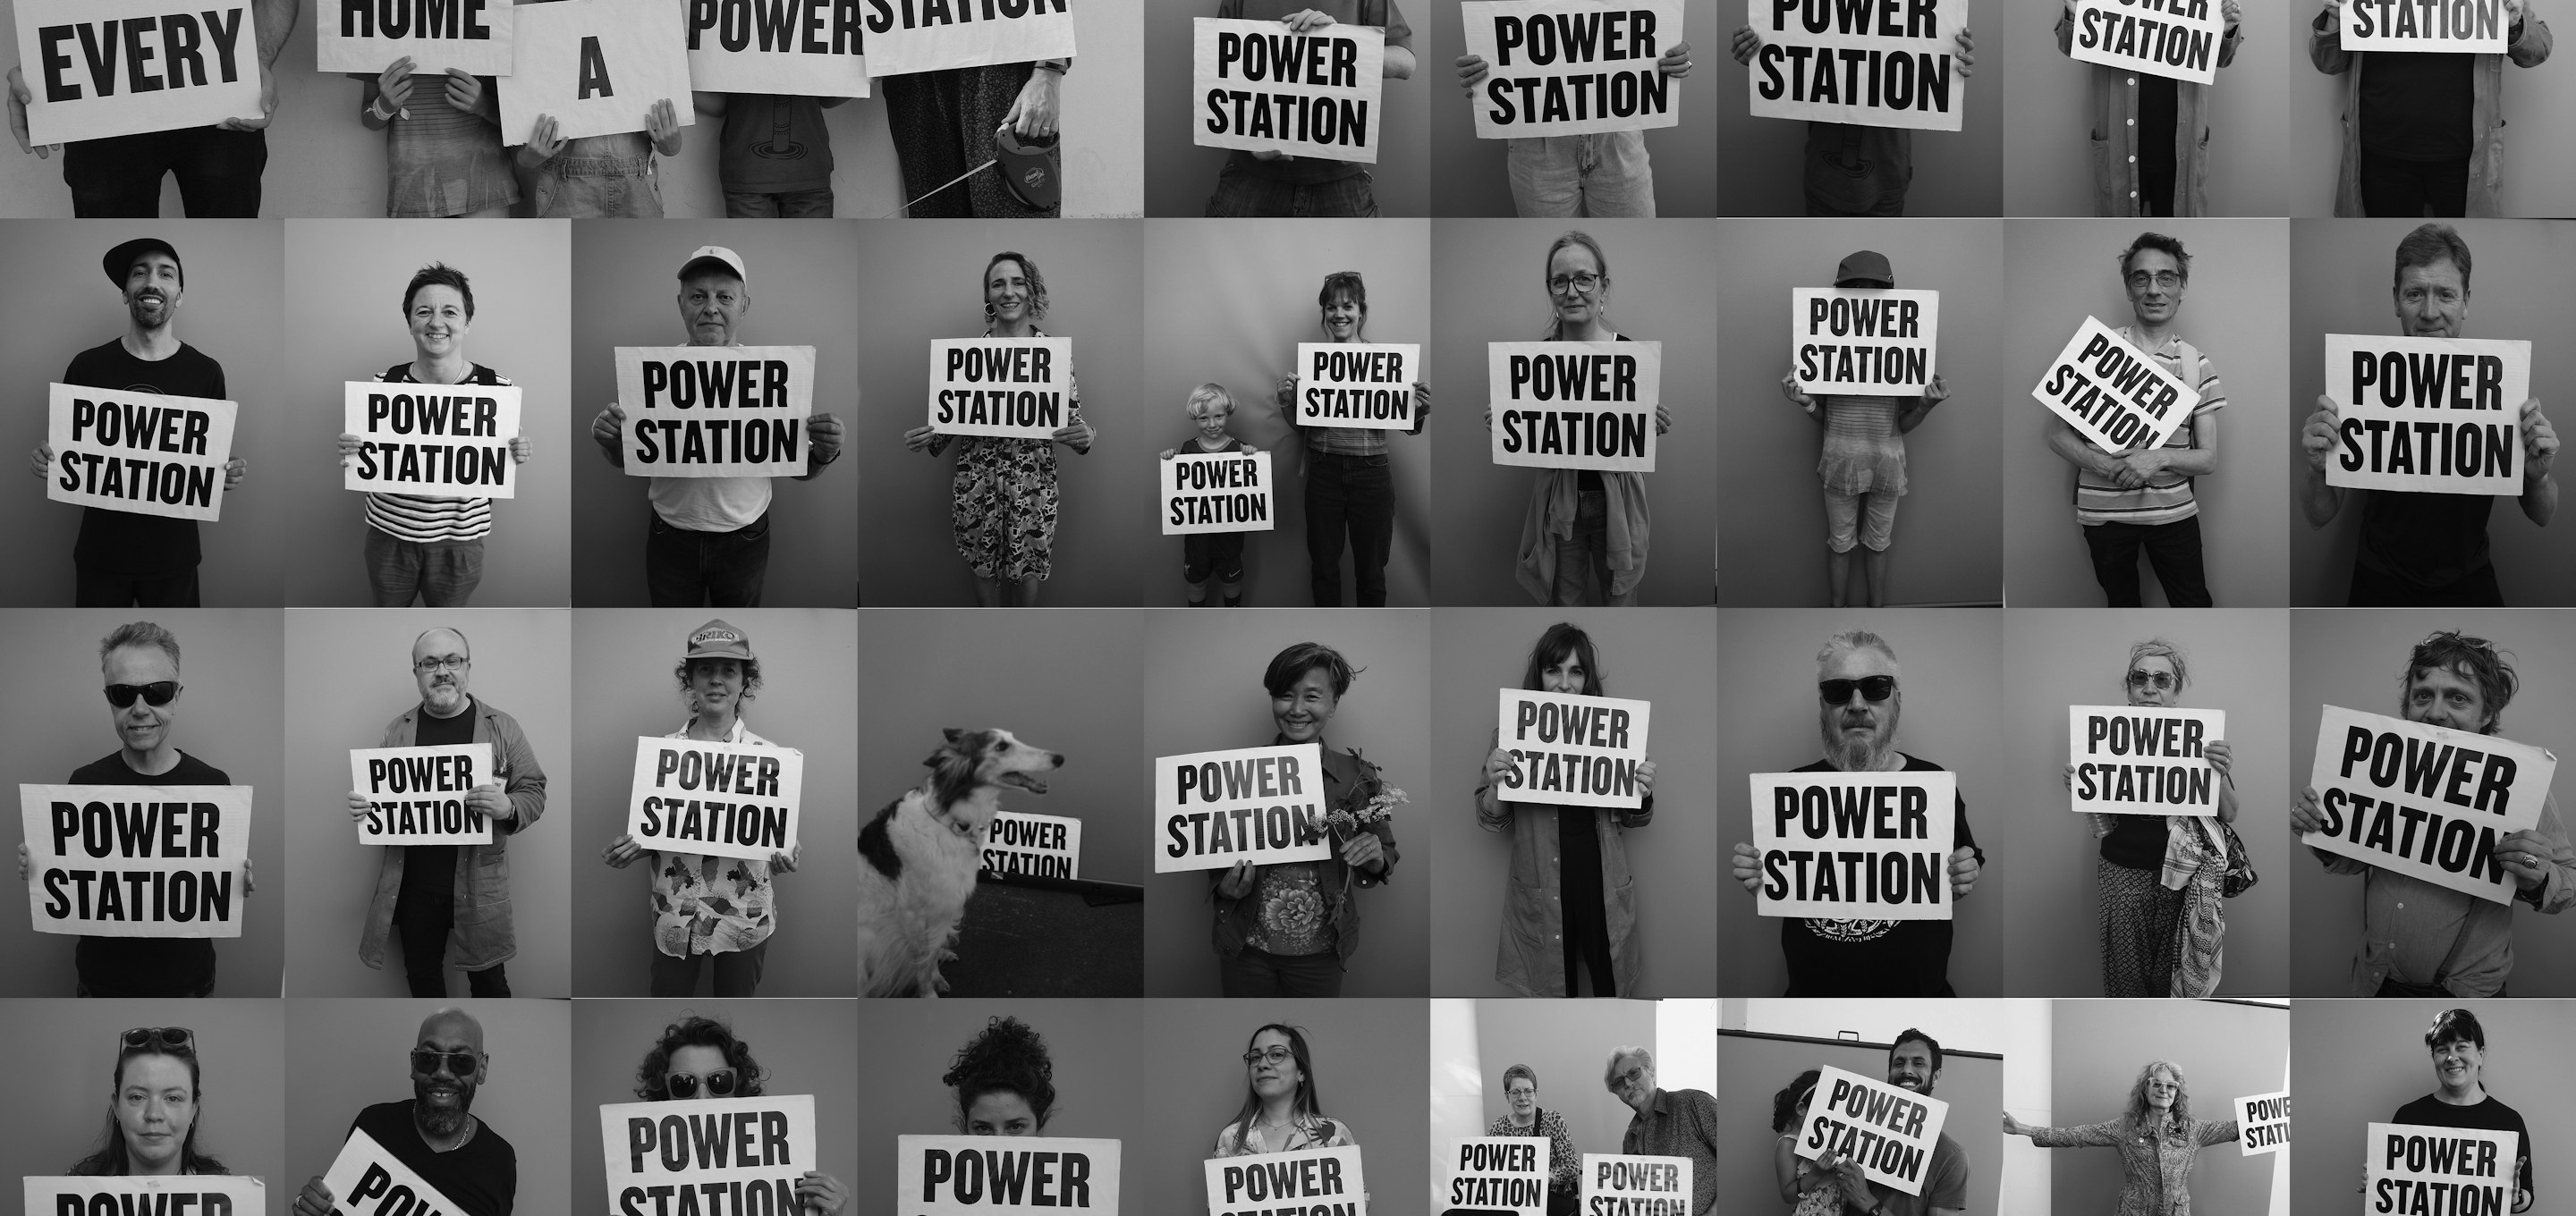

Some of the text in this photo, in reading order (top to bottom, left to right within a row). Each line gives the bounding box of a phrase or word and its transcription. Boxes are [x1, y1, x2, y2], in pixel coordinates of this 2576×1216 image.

[342, 0, 489, 39] HOME
[688, 0, 863, 55] POWER
[1495, 10, 1656, 66] POWER
[1774, 0, 1936, 38] POWER
[2080, 8, 2213, 72] STATION
[2353, 0, 2498, 39] STATION
[38, 8, 242, 103] EVERY
[579, 36, 614, 99] A
[1219, 32, 1357, 88] POWER
[1758, 44, 1950, 113] STATION
[1208, 89, 1367, 147] STATION
[1487, 71, 1668, 125] STATION
[1810, 298, 1919, 338] POWER
[643, 360, 788, 409] POWER
[947, 348, 1050, 383] POWER
[1314, 351, 1402, 383] POWER
[1511, 354, 1636, 401] POWER
[1801, 344, 1926, 384] STATION
[2078, 333, 2179, 422] POWER
[2353, 351, 2503, 410] POWER
[72, 399, 209, 455] POWER
[369, 394, 496, 436] POWER
[938, 390, 1059, 427] STATION
[1306, 388, 1408, 419] STATION
[2046, 365, 2161, 450] STATION
[635, 418, 798, 463] STATION
[1503, 410, 1646, 457] STATION
[2339, 418, 2513, 478] STATION
[60, 451, 215, 507] STATION
[357, 441, 506, 486] STATION
[1176, 460, 1258, 490] POWER
[1171, 494, 1266, 525] STATION
[1517, 700, 1629, 748] POWER
[2089, 716, 2203, 758] POWER
[369, 755, 472, 794] POWER
[657, 749, 779, 797] POWER
[1178, 756, 1302, 805] POWER
[1505, 749, 1636, 798] STATION
[2078, 763, 2211, 805] STATION
[2341, 726, 2516, 815] POWER
[51, 801, 219, 857] POWER
[367, 799, 483, 835] STATION
[641, 797, 787, 849] STATION
[989, 819, 1066, 850] POWER
[1167, 804, 1319, 858] STATION
[1775, 786, 1928, 839] POWER
[2320, 788, 2511, 886] STATION
[983, 849, 1072, 880] STATION
[1765, 849, 1940, 904] STATION
[44, 868, 232, 922] STATION
[1827, 1078, 1928, 1139] POWER
[629, 1111, 791, 1173] POWER
[1461, 1144, 1536, 1173] POWER
[1808, 1117, 1925, 1183] STATION
[2387, 1135, 2496, 1177] POWER
[924, 1149, 1089, 1207] POWER
[1224, 1158, 1343, 1203] POWER
[1452, 1178, 1541, 1207] STATION
[1597, 1162, 1678, 1192] POWER
[2376, 1178, 2503, 1216] STATION
[1590, 1195, 1684, 1216] STATION
